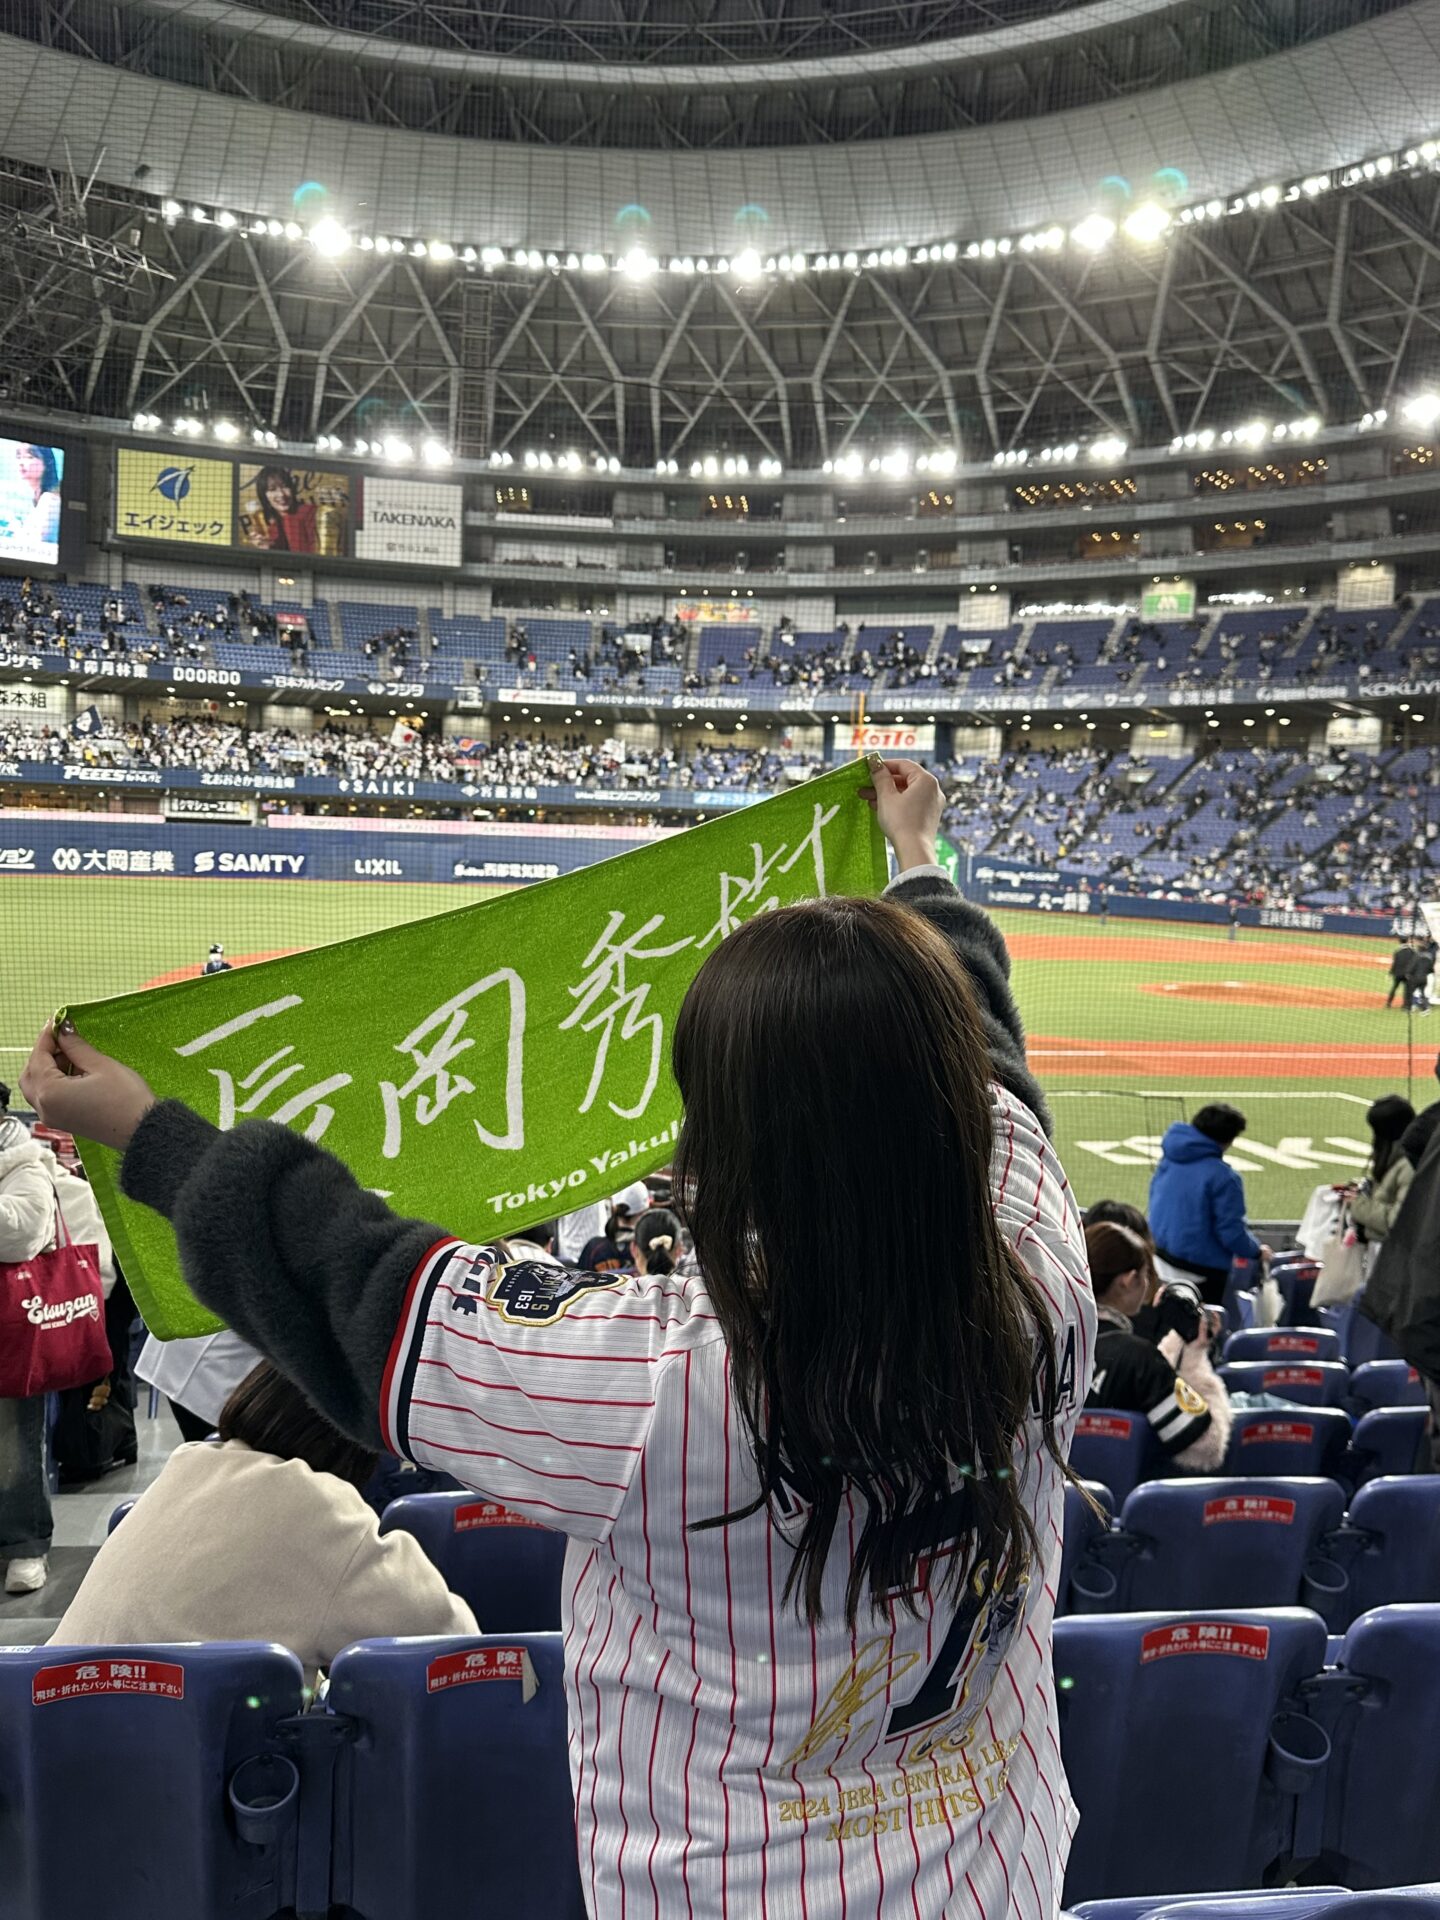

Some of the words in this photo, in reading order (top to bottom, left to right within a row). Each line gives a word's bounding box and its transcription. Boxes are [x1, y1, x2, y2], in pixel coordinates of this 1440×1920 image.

[124, 512, 225, 537] エイジェック
[371, 510, 457, 530] TAKENAKA
[173, 666, 241, 686] DOORDO
[385, 683, 425, 698] フジタ
[353, 779, 415, 796] SAIKI
[82, 849, 175, 873] 大岡産業
[218, 852, 305, 874] SAMTY
[354, 858, 402, 876] LIXIL
[487, 1168, 588, 1214] Tokyo
[589, 1115, 686, 1175] Yakul
[21, 1293, 98, 1325] Etsuzan
[514, 1289, 535, 1311] 163
[1170, 1624, 1233, 1643] 危険!!
[75, 1663, 147, 1681] 危険!!
[779, 1797, 831, 1822] 2024
[836, 1783, 888, 1813] JERA
[891, 1759, 982, 1799] CENTRAL
[825, 1806, 906, 1842] MOST
[914, 1786, 980, 1829] HITS
